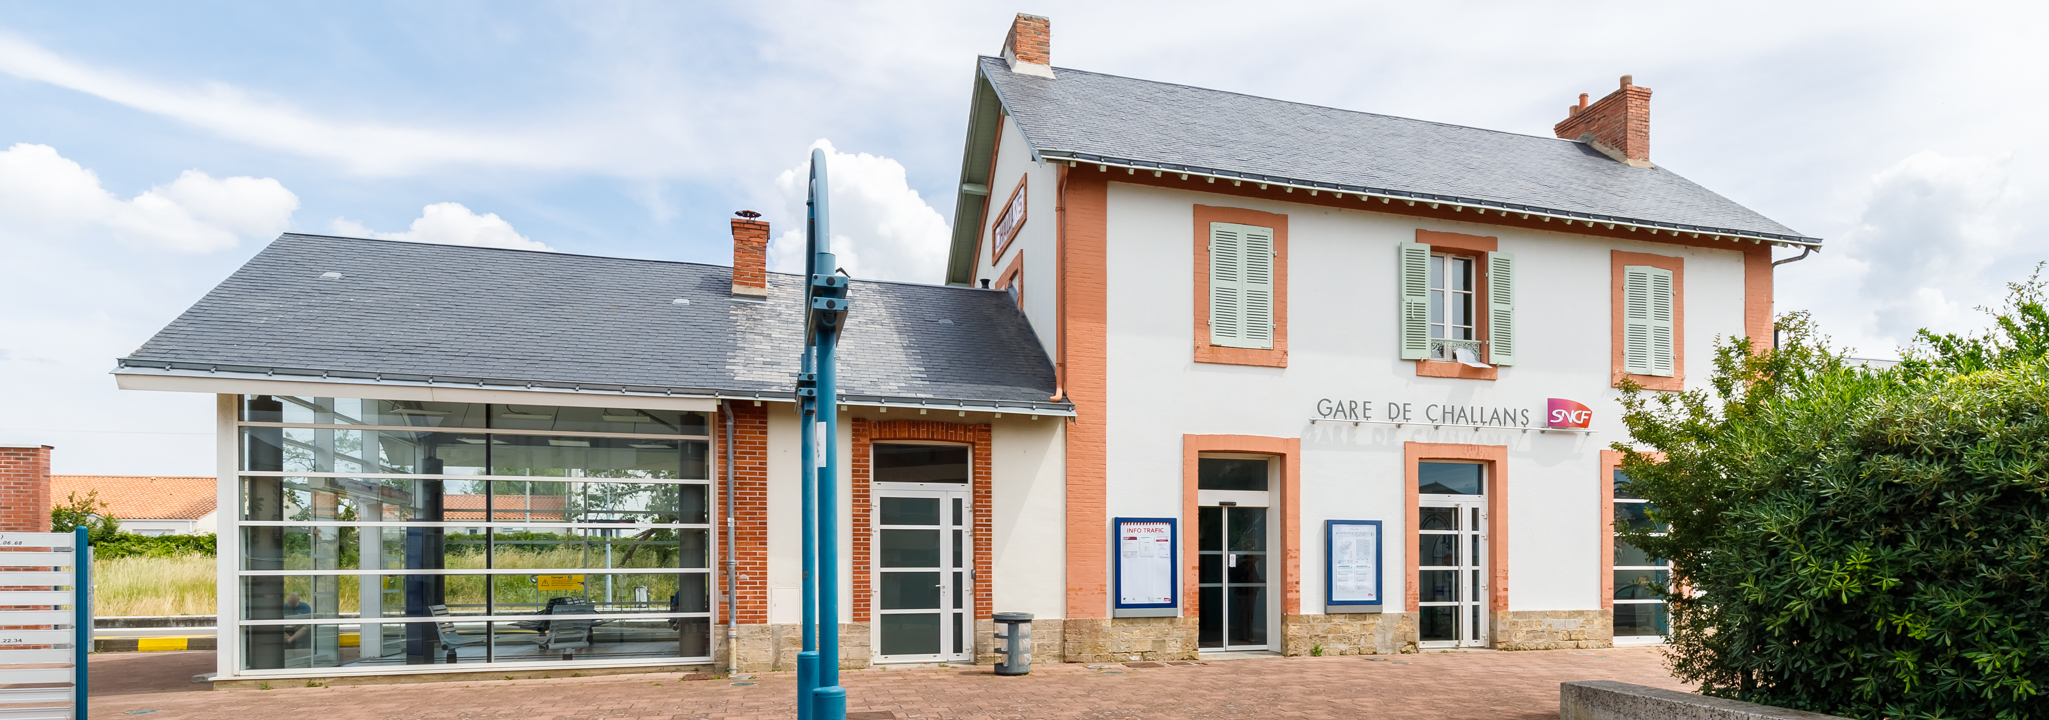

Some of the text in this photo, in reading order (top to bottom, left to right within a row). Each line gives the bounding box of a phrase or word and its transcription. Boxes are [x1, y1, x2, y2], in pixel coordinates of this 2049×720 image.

[1316, 398, 1530, 427] GARE DE CHALLANS
[1549, 408, 1592, 424] SNCF
